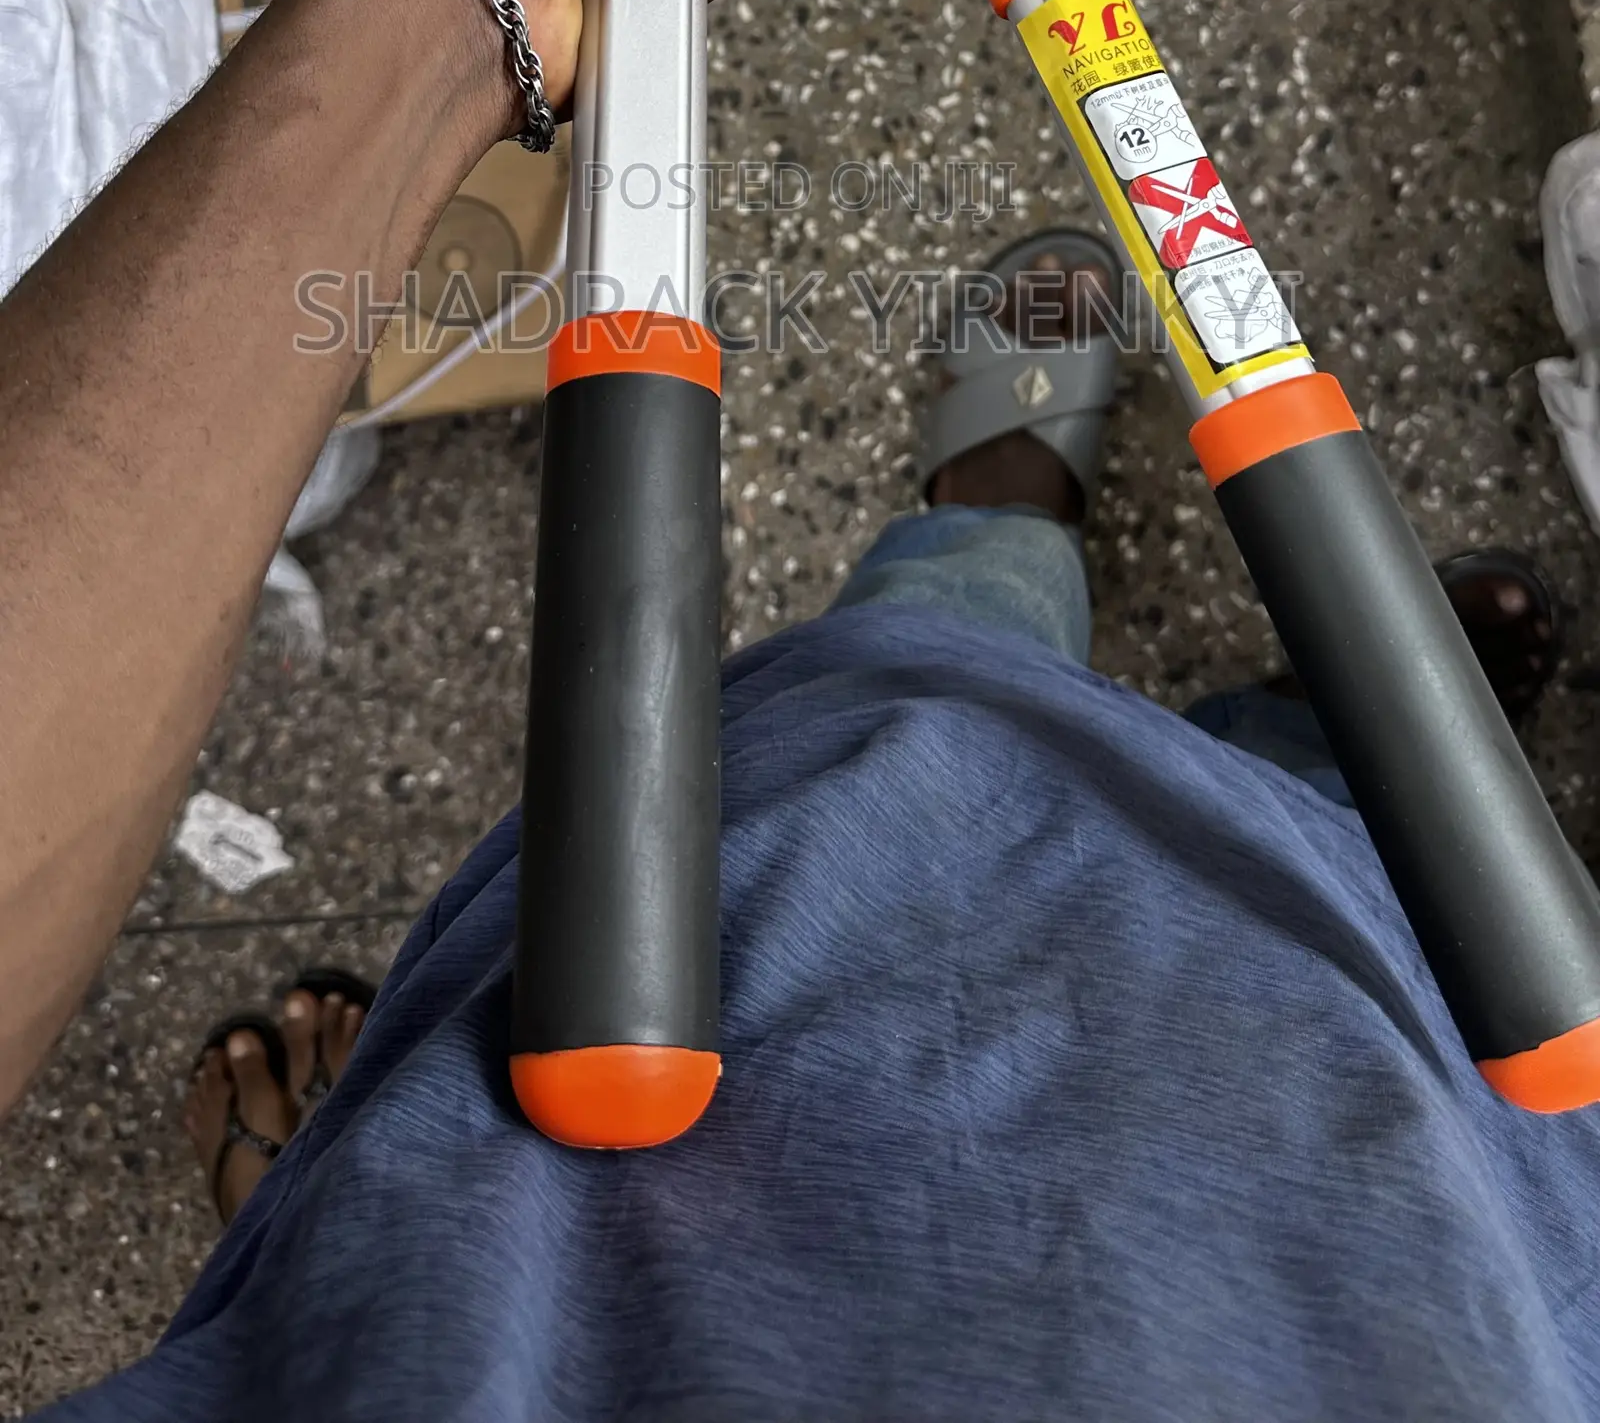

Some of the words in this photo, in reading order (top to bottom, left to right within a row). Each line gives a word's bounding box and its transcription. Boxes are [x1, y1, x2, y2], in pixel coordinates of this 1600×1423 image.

[1062, 38, 1153, 80] NAVIGATIO
[1119, 127, 1150, 149] 12
[1133, 145, 1152, 157] mm
